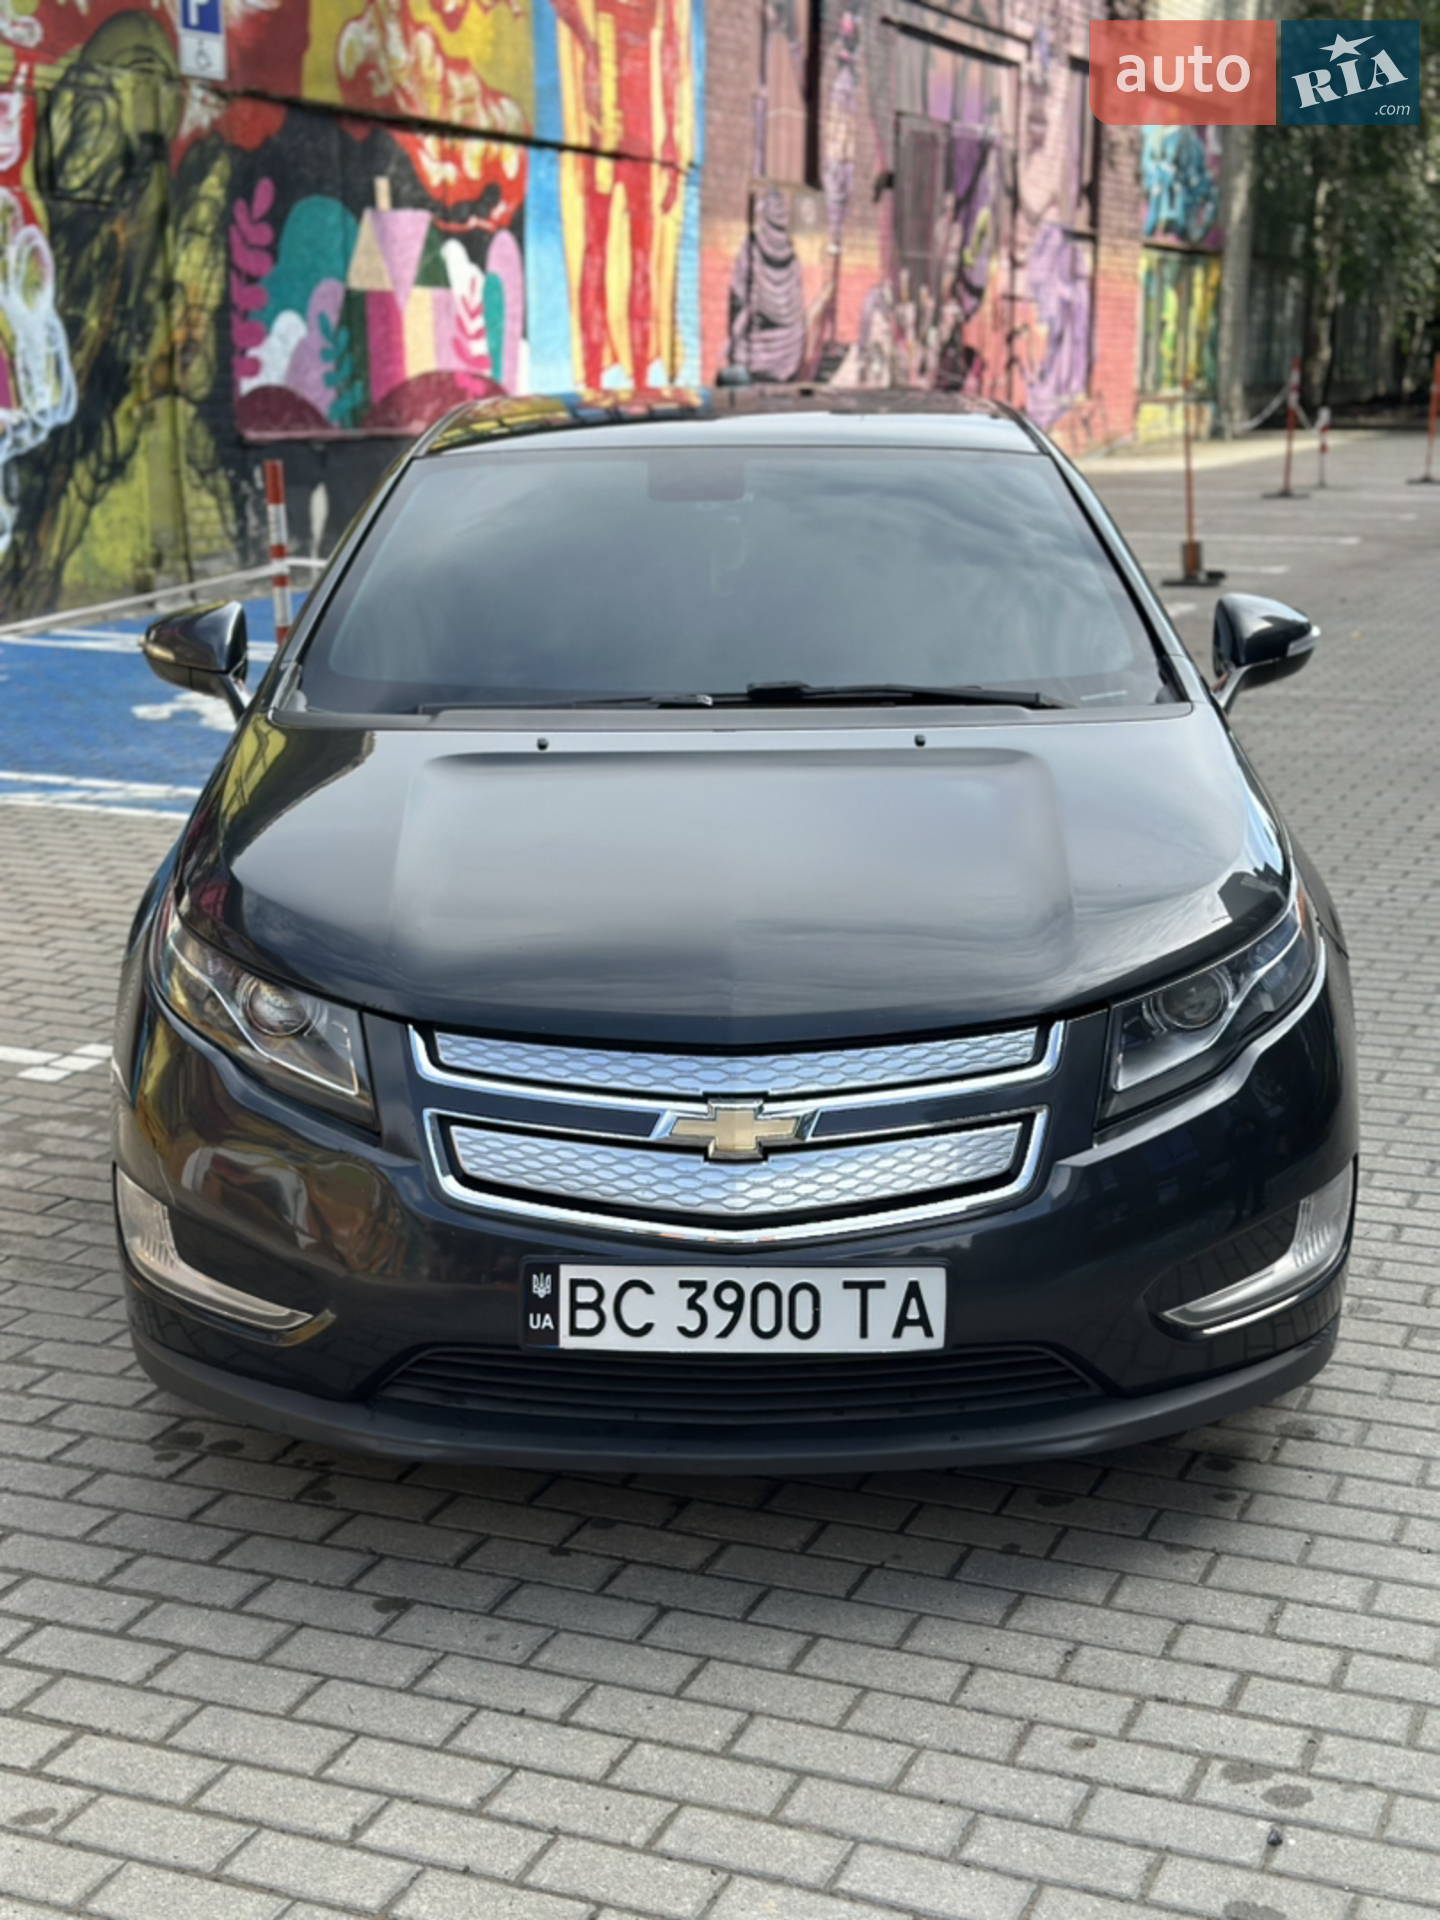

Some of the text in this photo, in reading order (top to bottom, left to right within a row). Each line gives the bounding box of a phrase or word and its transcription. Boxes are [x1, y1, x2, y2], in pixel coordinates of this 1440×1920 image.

[529, 1313, 555, 1330] UA
[568, 1278, 935, 1339] BC 3900 TA
